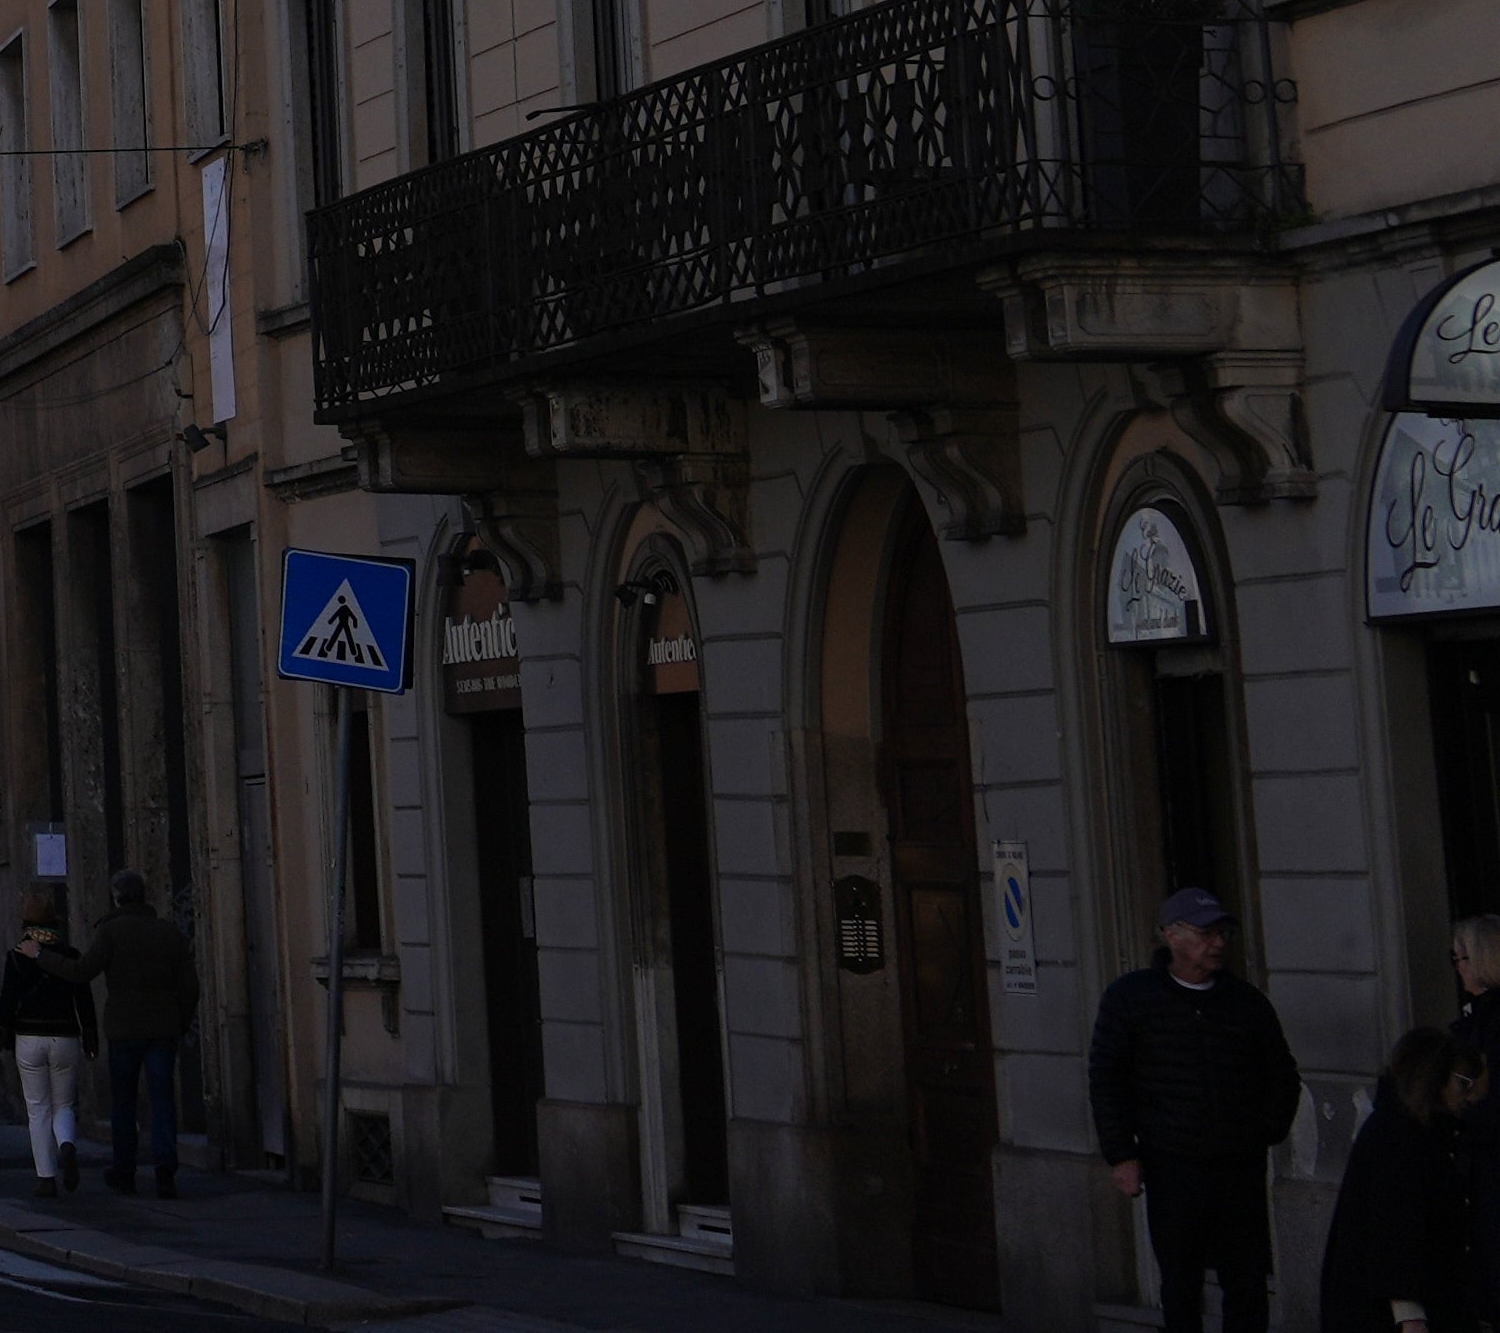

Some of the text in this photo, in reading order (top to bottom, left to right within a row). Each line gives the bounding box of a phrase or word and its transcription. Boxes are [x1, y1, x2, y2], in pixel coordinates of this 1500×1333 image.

[1437, 294, 1500, 364] Le
[1385, 451, 1440, 593] Le
[1139, 542, 1188, 601] Grazie
